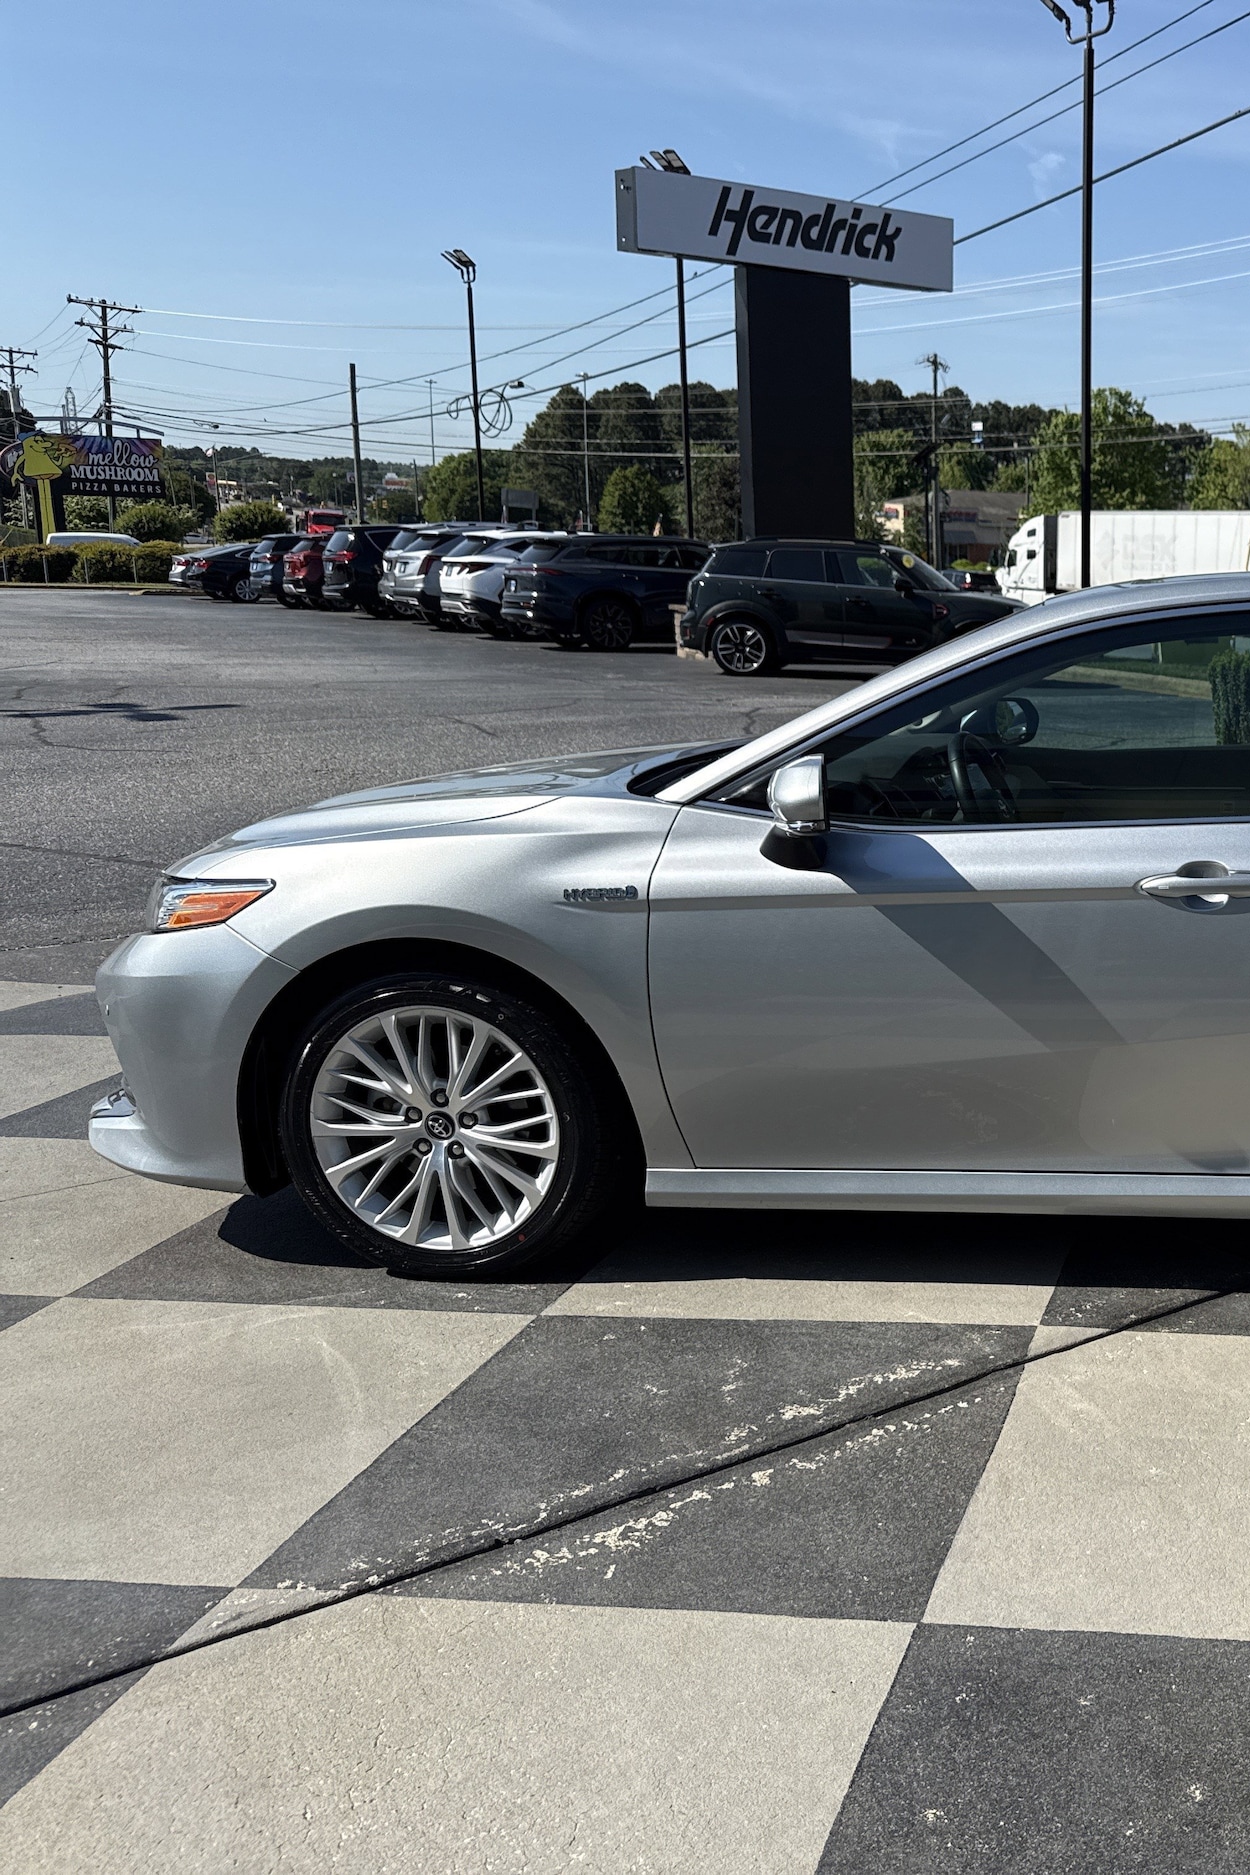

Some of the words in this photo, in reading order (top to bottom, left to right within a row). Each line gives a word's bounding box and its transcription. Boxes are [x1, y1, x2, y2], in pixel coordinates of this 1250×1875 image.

[708, 186, 902, 263] Hendrick
[88, 439, 158, 467] mellow
[70, 464, 160, 482] MUSHROOM
[71, 482, 108, 492] PIZZA
[114, 483, 162, 494] BAKERS
